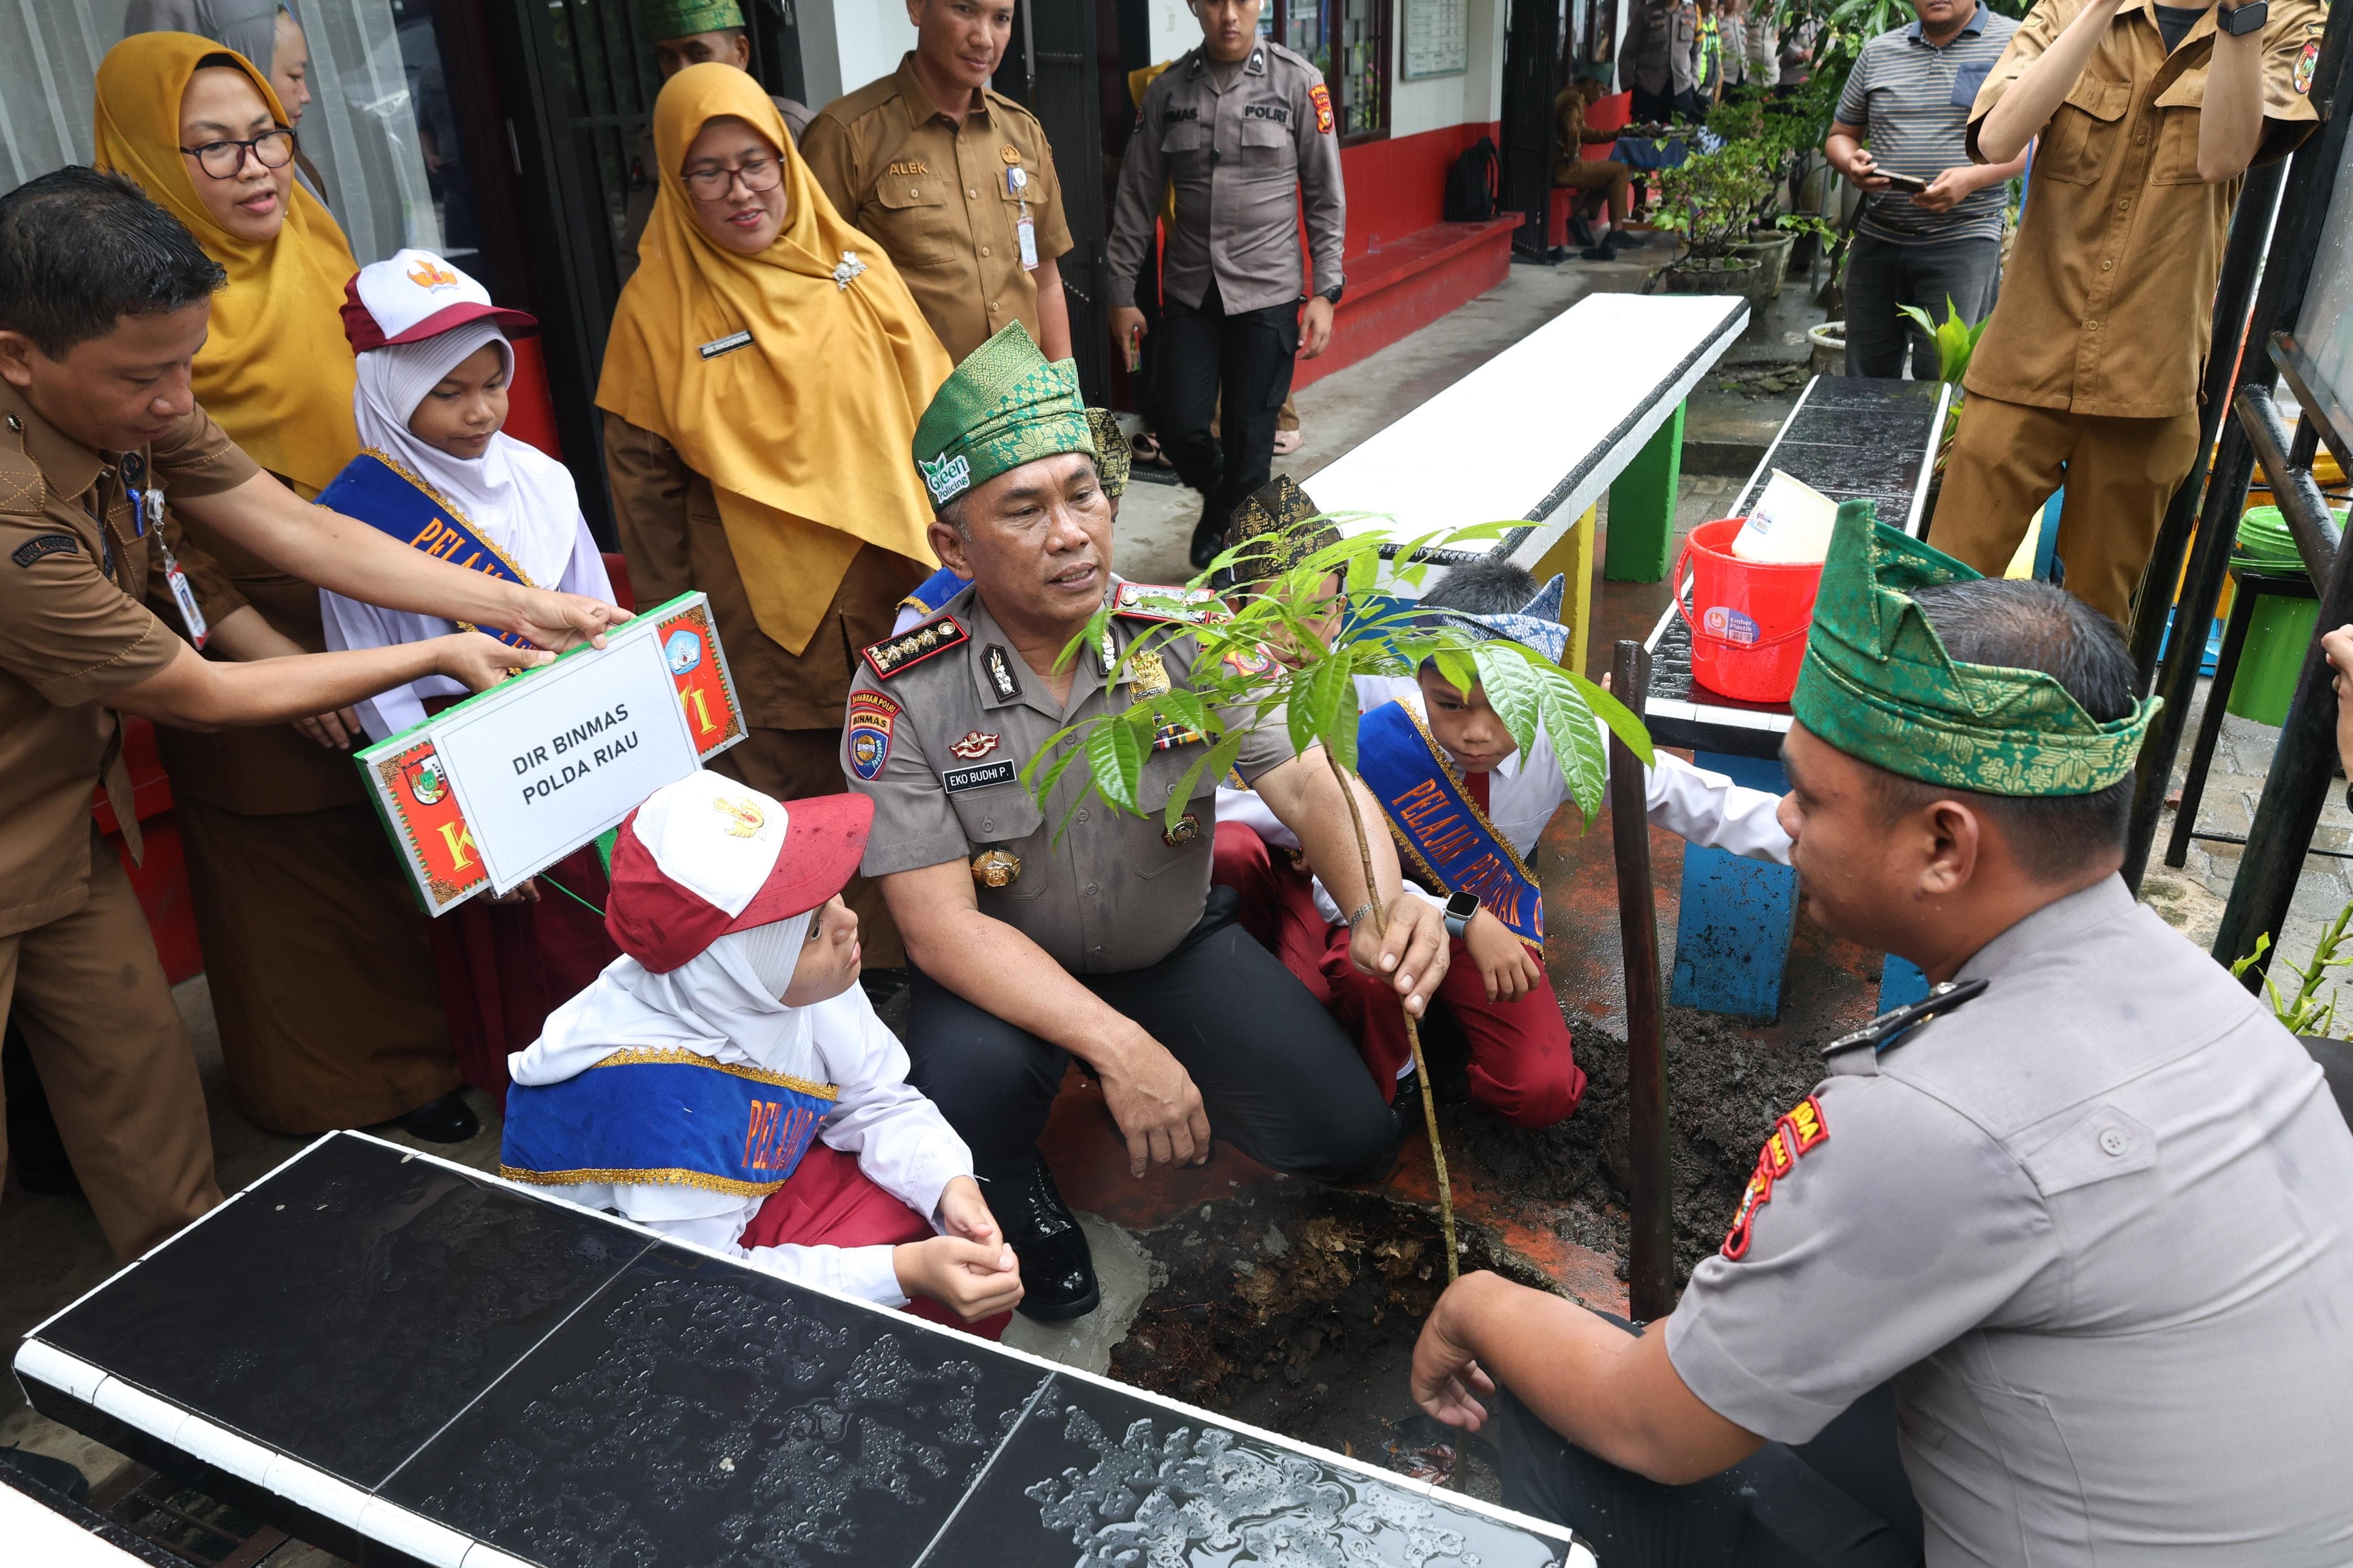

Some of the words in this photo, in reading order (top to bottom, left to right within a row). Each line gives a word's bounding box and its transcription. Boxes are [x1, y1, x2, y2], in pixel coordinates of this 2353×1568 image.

[1245, 106, 1288, 123] POLRI
[888, 162, 928, 176] ALEK
[938, 476, 968, 499] Policing
[1730, 623, 1752, 632] Plastik
[853, 715, 887, 728] BINMAS
[512, 746, 549, 776] DIR
[552, 703, 628, 755] BINMAS
[522, 759, 591, 805] POLDA
[593, 731, 639, 767] RIAU
[950, 774, 968, 786] EKO
[969, 768, 998, 783] BUDHI
[999, 767, 1009, 777] P.
[1391, 778, 1479, 866] PELAJAR
